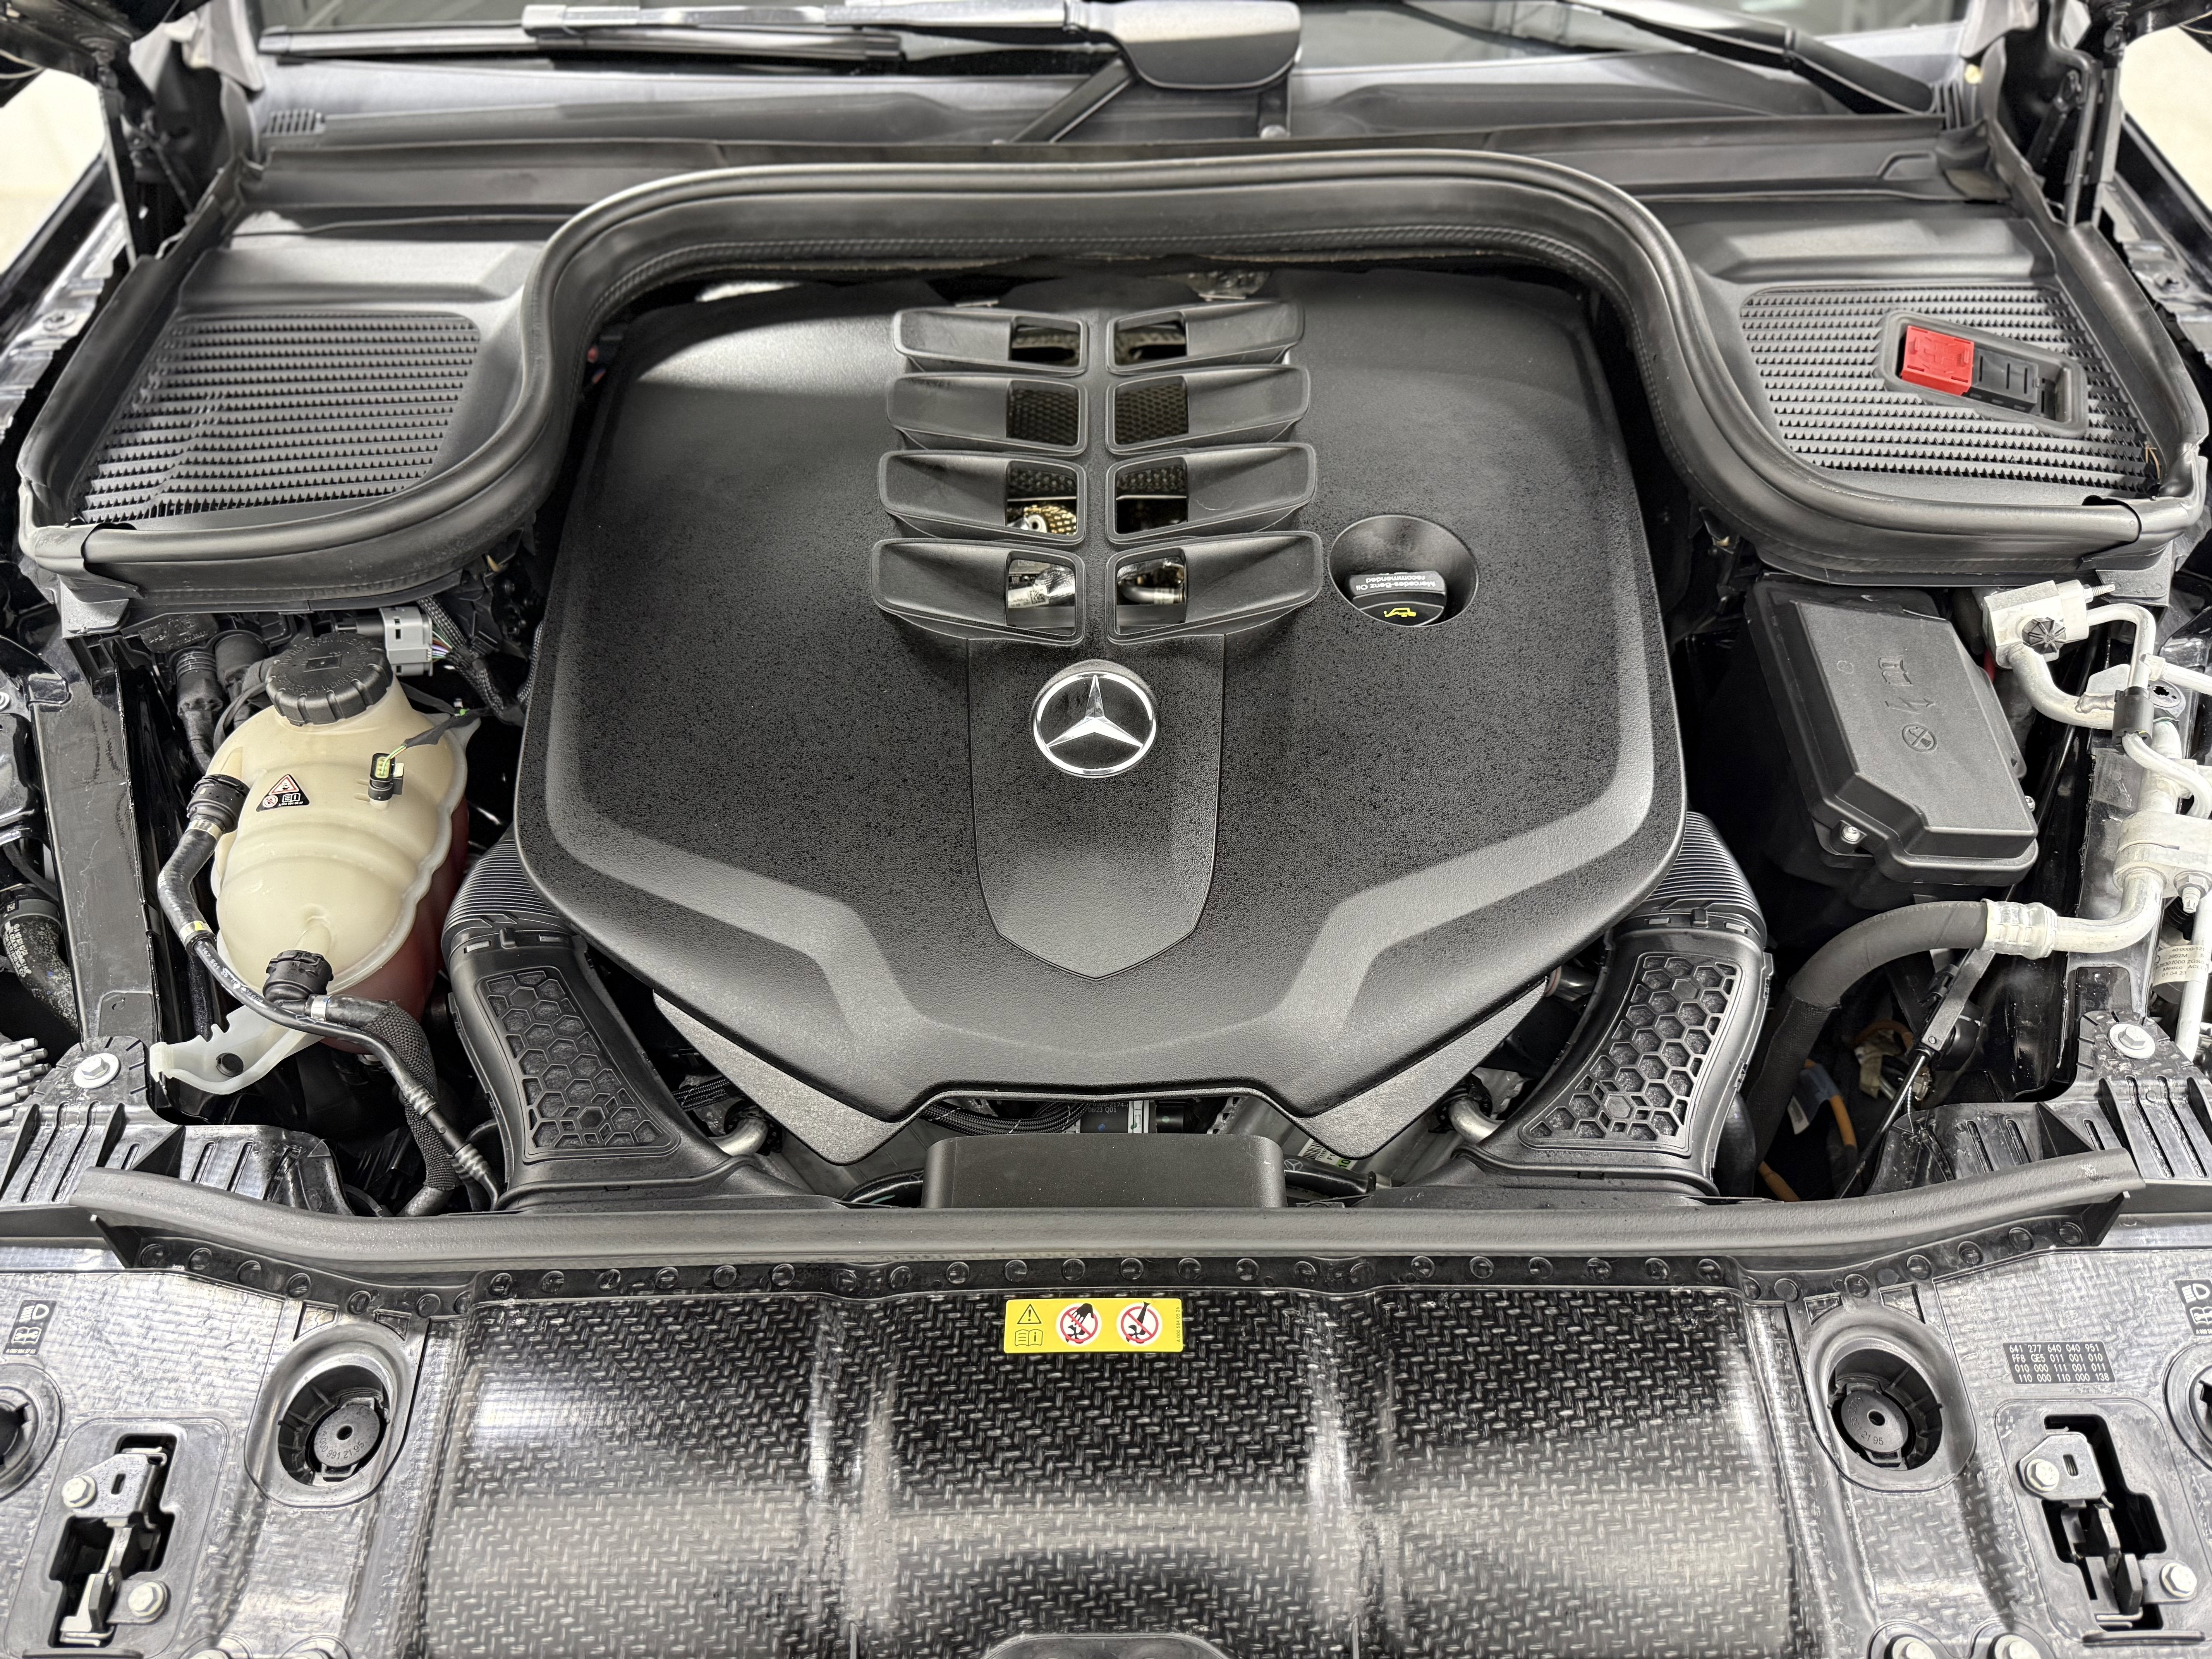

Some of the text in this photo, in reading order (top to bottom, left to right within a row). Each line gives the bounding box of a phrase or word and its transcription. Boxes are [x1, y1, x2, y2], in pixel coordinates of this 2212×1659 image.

[1366, 575, 1425, 584] recommended
[310, 637, 333, 647] OPEN
[201, 947, 211, 958] 167
[210, 959, 220, 970] 501
[1338, 1159, 1352, 1168] 10
[2009, 1343, 2099, 1353] 641 277 640 040 951
[2012, 1353, 2103, 1363] FF8 GE5 011 001 010
[2014, 1363, 2106, 1373] 010 000 111 001 011
[2019, 1373, 2109, 1382] 110 000 110 000 138
[1873, 1436, 1884, 1445] 95
[319, 1437, 328, 1452] 000
[326, 1450, 341, 1460] 991
[343, 1449, 353, 1459] 21
[354, 1441, 365, 1452] 95
